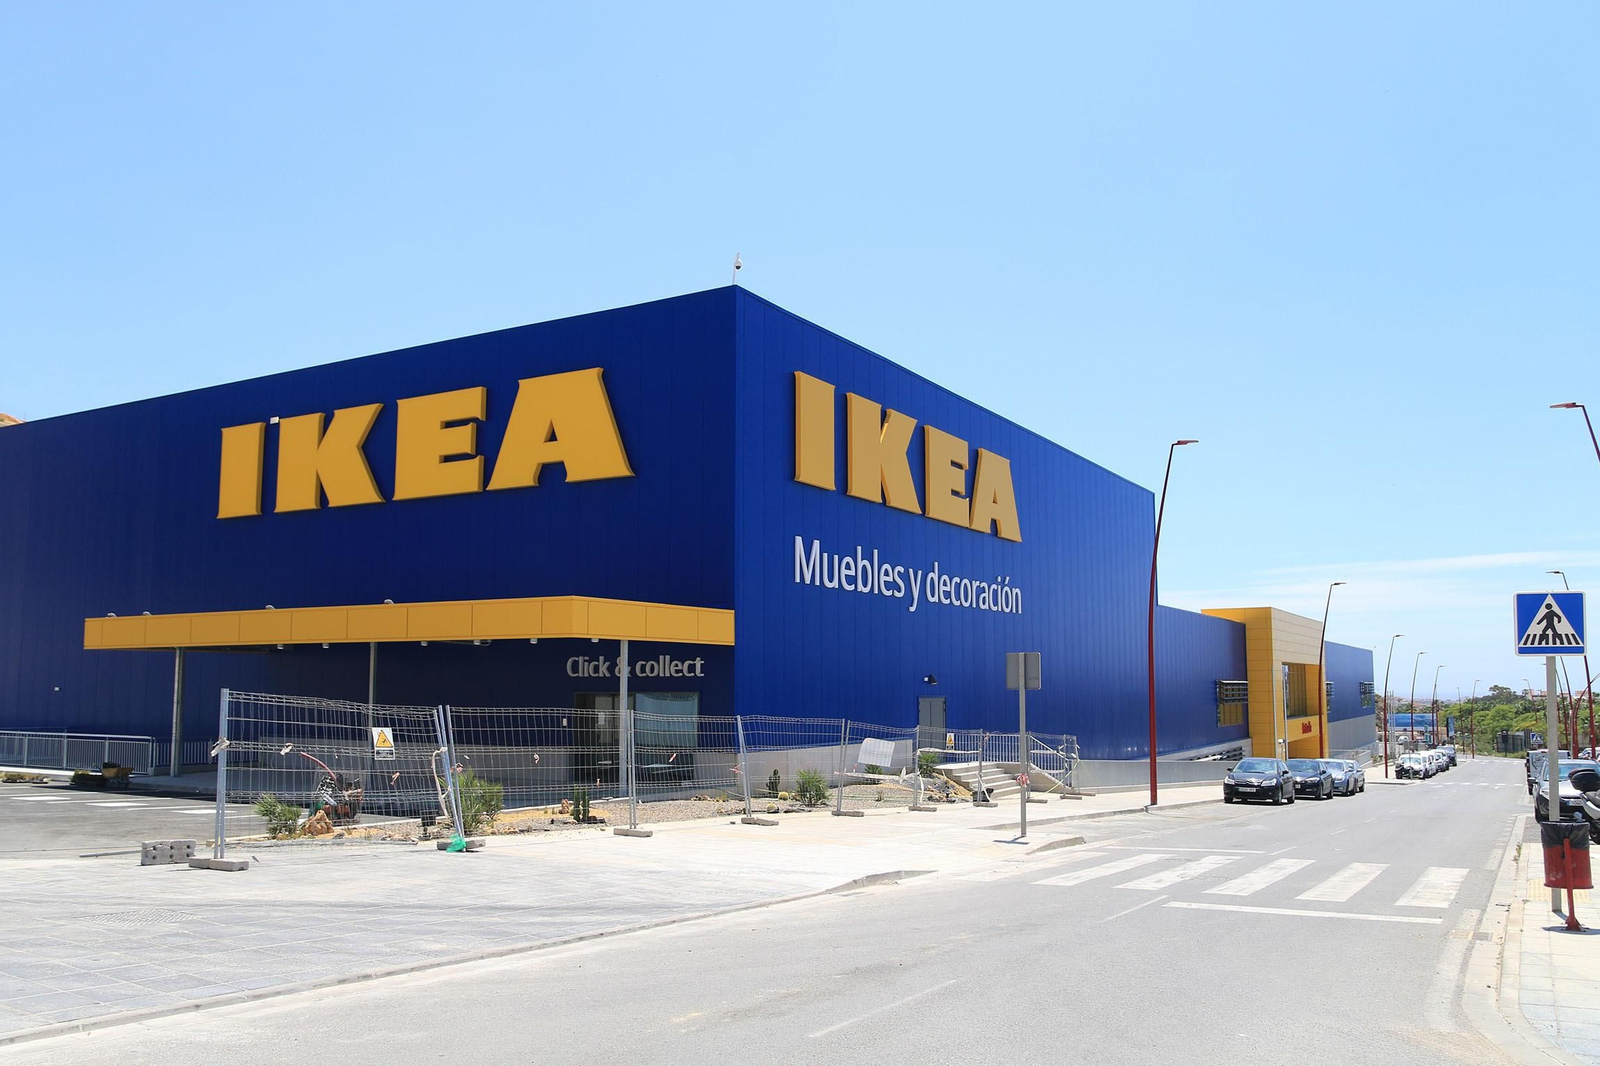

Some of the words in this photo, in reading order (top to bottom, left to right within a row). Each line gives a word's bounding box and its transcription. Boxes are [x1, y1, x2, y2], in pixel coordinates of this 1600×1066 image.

[216, 367, 636, 519] IKEA
[794, 370, 1022, 542] IKEA
[794, 535, 905, 598] Muebles
[908, 568, 922, 611] y
[925, 561, 1022, 614] decoración
[566, 656, 611, 677] Click
[635, 655, 705, 677] collect
